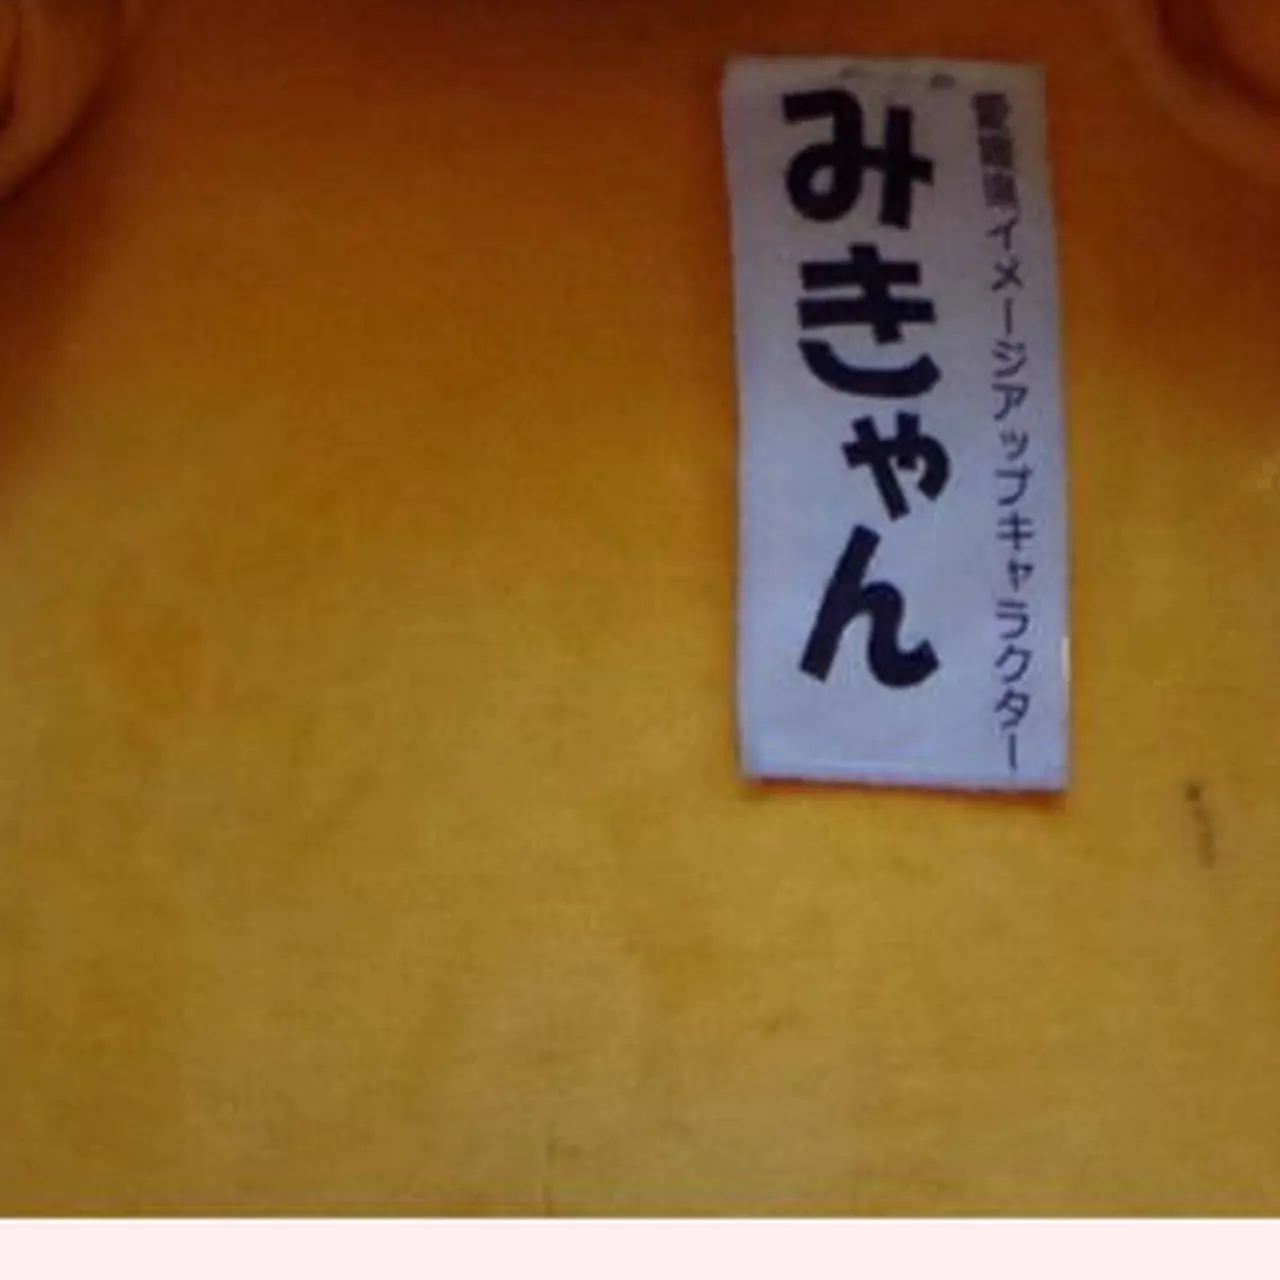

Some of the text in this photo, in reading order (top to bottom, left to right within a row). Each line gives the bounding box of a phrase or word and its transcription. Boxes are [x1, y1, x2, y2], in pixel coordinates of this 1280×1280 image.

[781, 89, 951, 691] みきゃん
[970, 91, 1034, 771] イメージアップキャラクター
